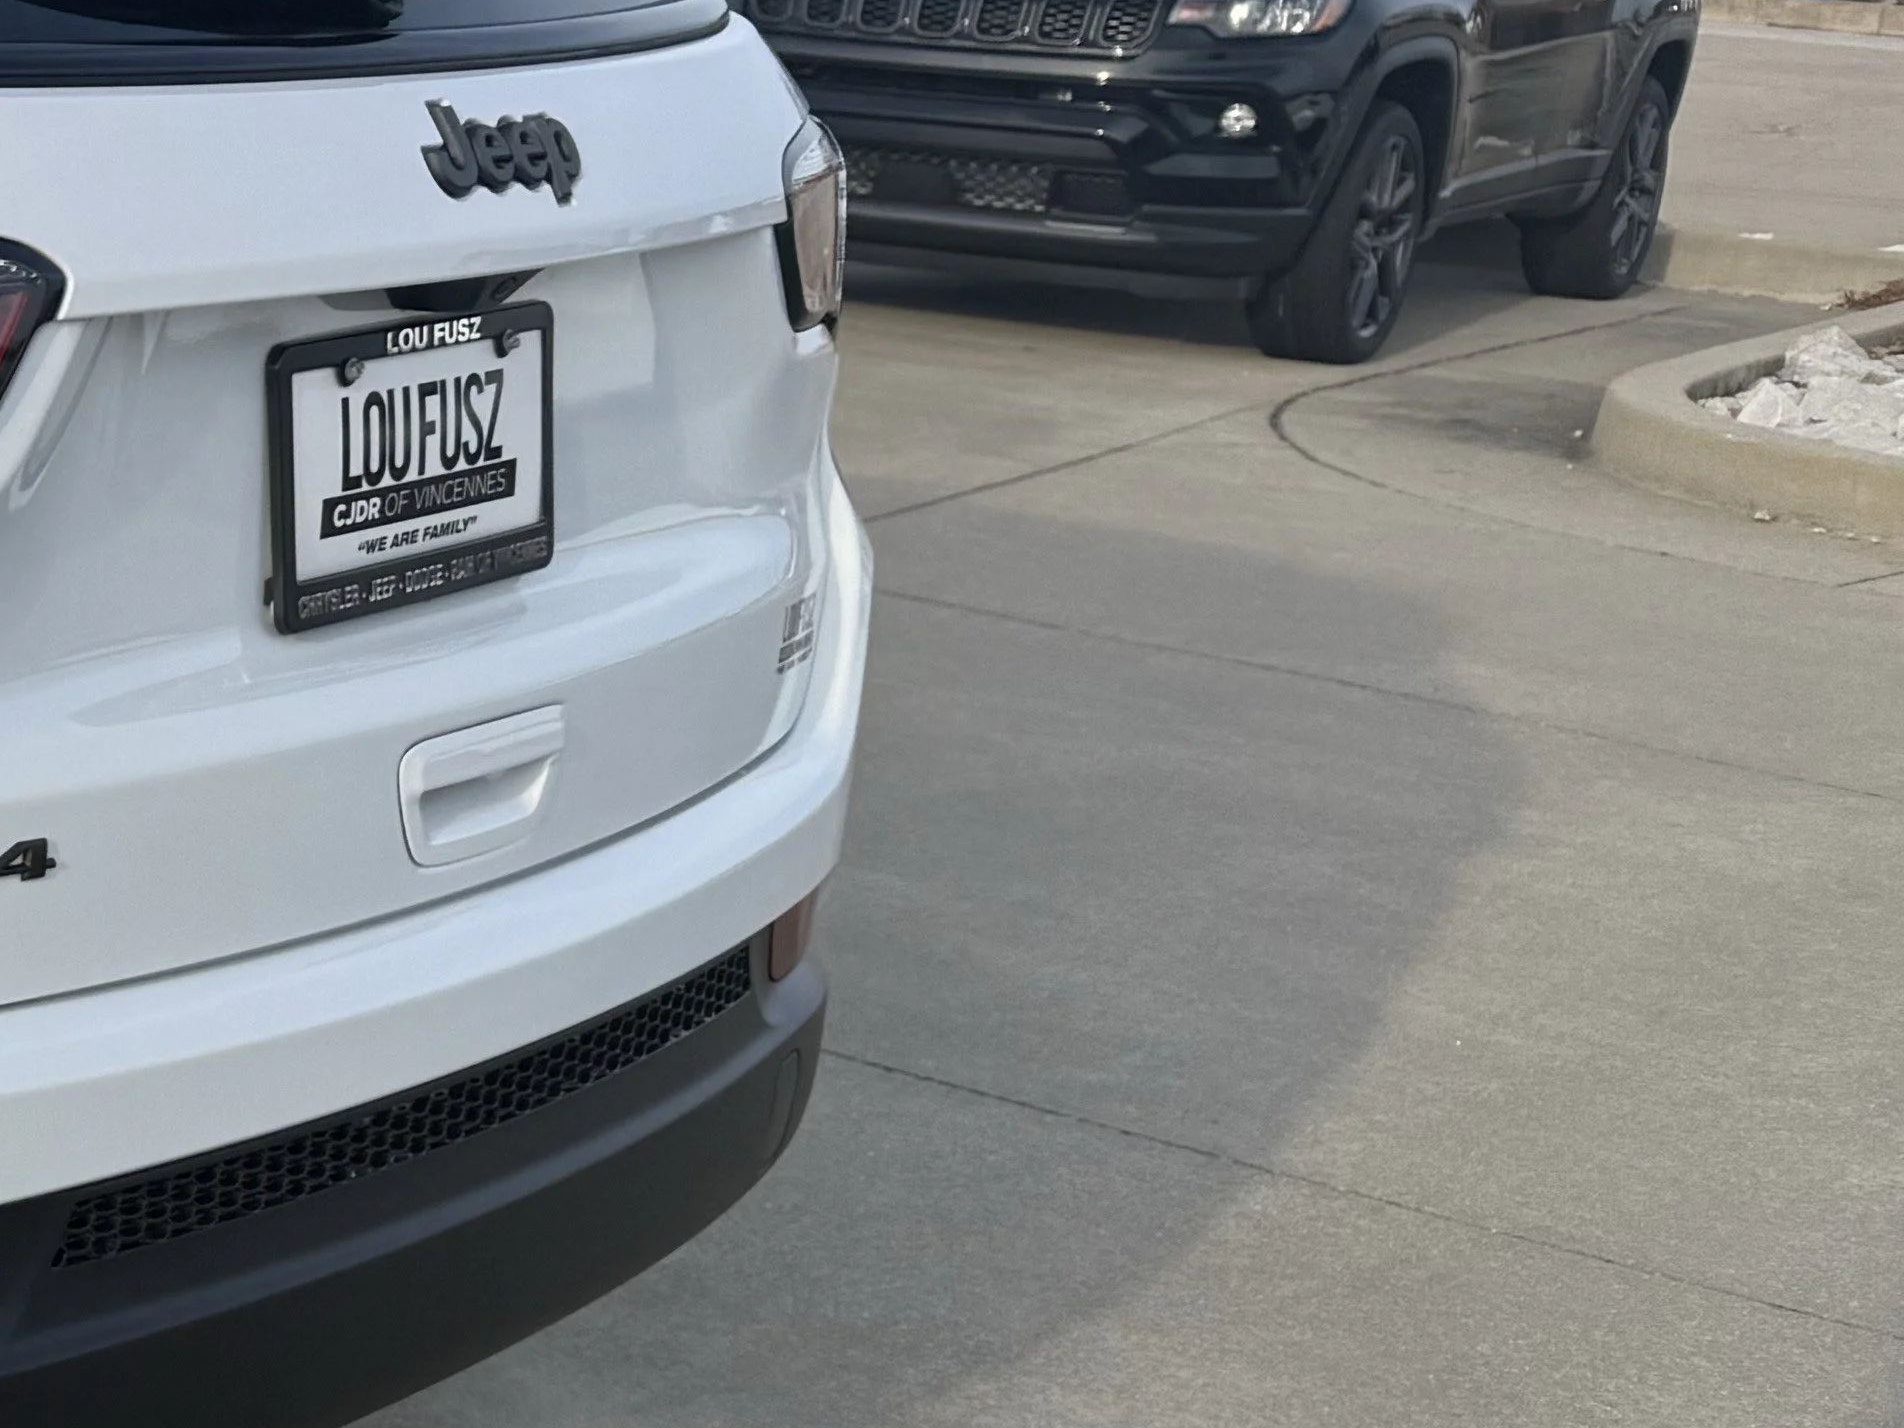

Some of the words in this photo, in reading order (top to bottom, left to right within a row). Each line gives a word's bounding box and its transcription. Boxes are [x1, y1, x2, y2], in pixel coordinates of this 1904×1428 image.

[421, 97, 582, 207] Jeep
[386, 325, 429, 355] LOU
[433, 316, 482, 347] FUSZ
[341, 385, 411, 492] LOU
[417, 368, 504, 477] FUSZ
[333, 496, 382, 528] CJDR
[385, 489, 412, 517] OF
[414, 468, 506, 510] VINCENNES
[390, 530, 417, 550] ARE
[298, 583, 360, 620] CHRYSLER
[369, 574, 397, 603] JEEP
[405, 563, 444, 593] DODGE
